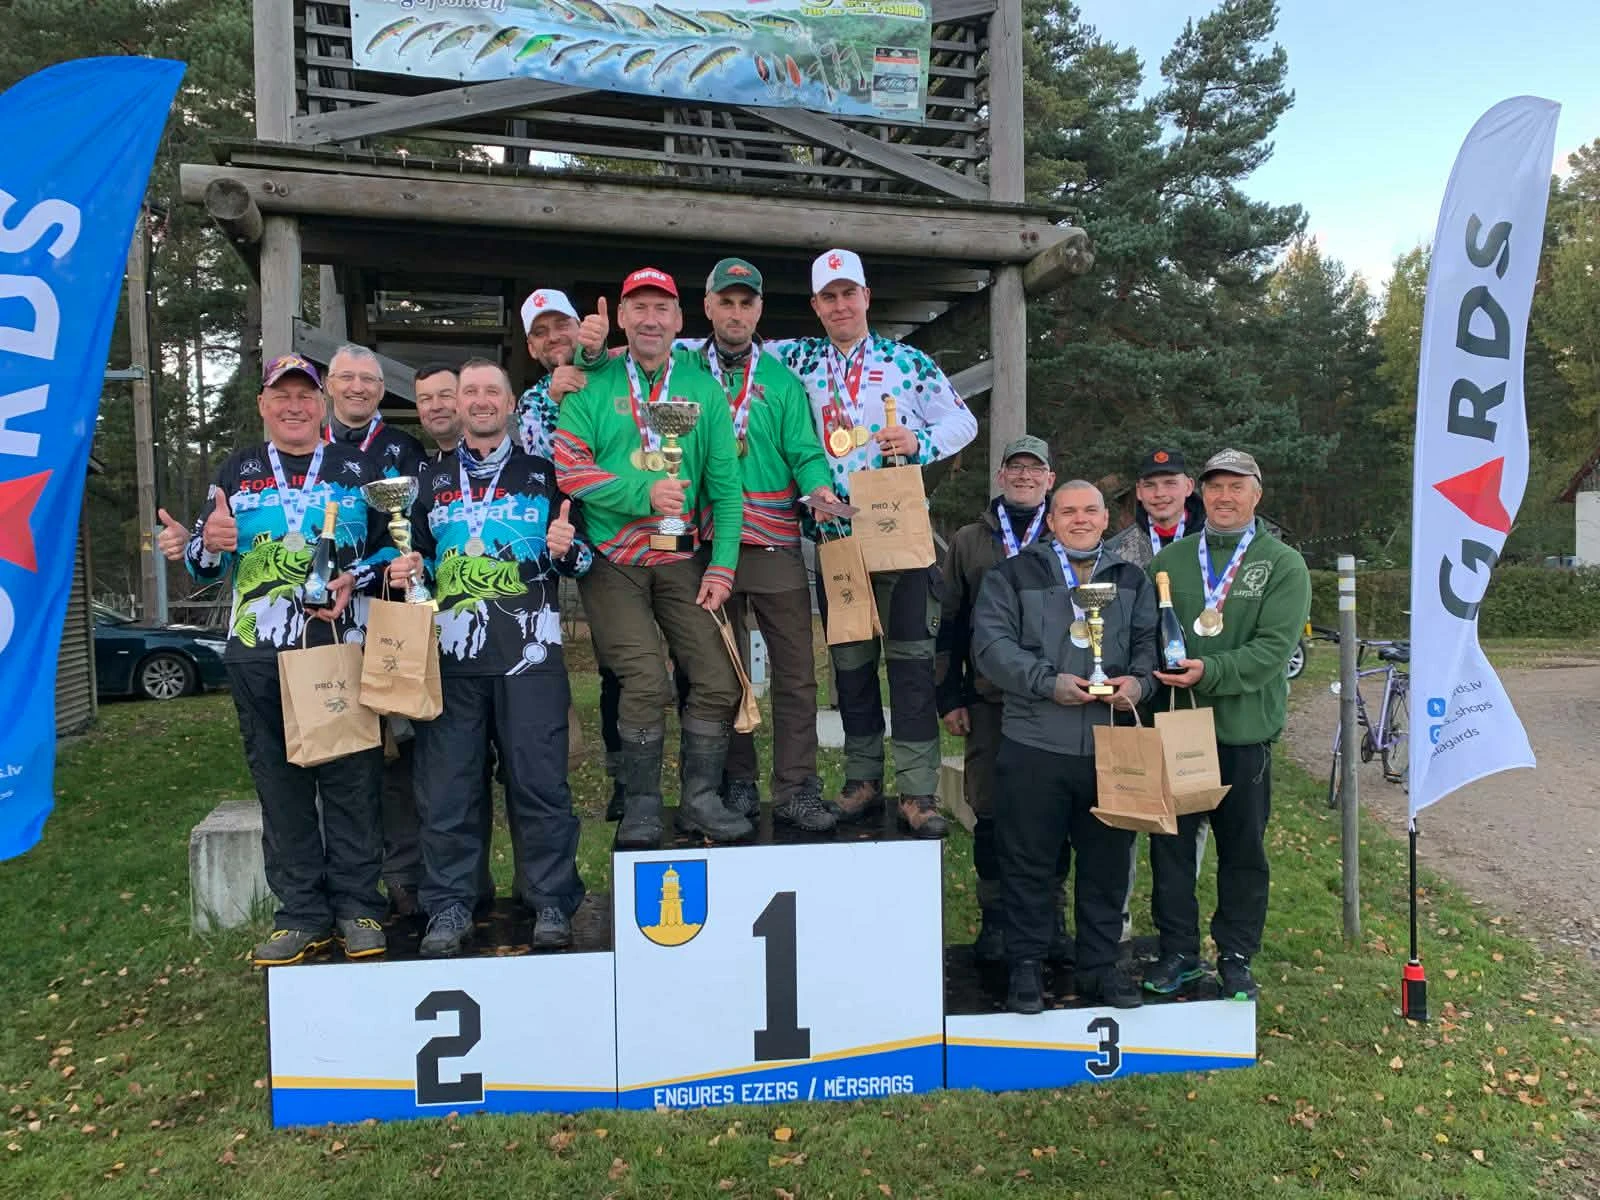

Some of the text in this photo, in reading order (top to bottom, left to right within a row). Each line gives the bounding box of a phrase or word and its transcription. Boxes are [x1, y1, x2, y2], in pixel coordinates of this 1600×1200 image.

[753, 891, 810, 1062] 1
[414, 989, 484, 1105] 2
[654, 1084, 734, 1106] ENGURES
[742, 1081, 798, 1101] EZERS
[824, 1075, 914, 1097] MĒRSRAGS
[1086, 1016, 1120, 1077] 3
